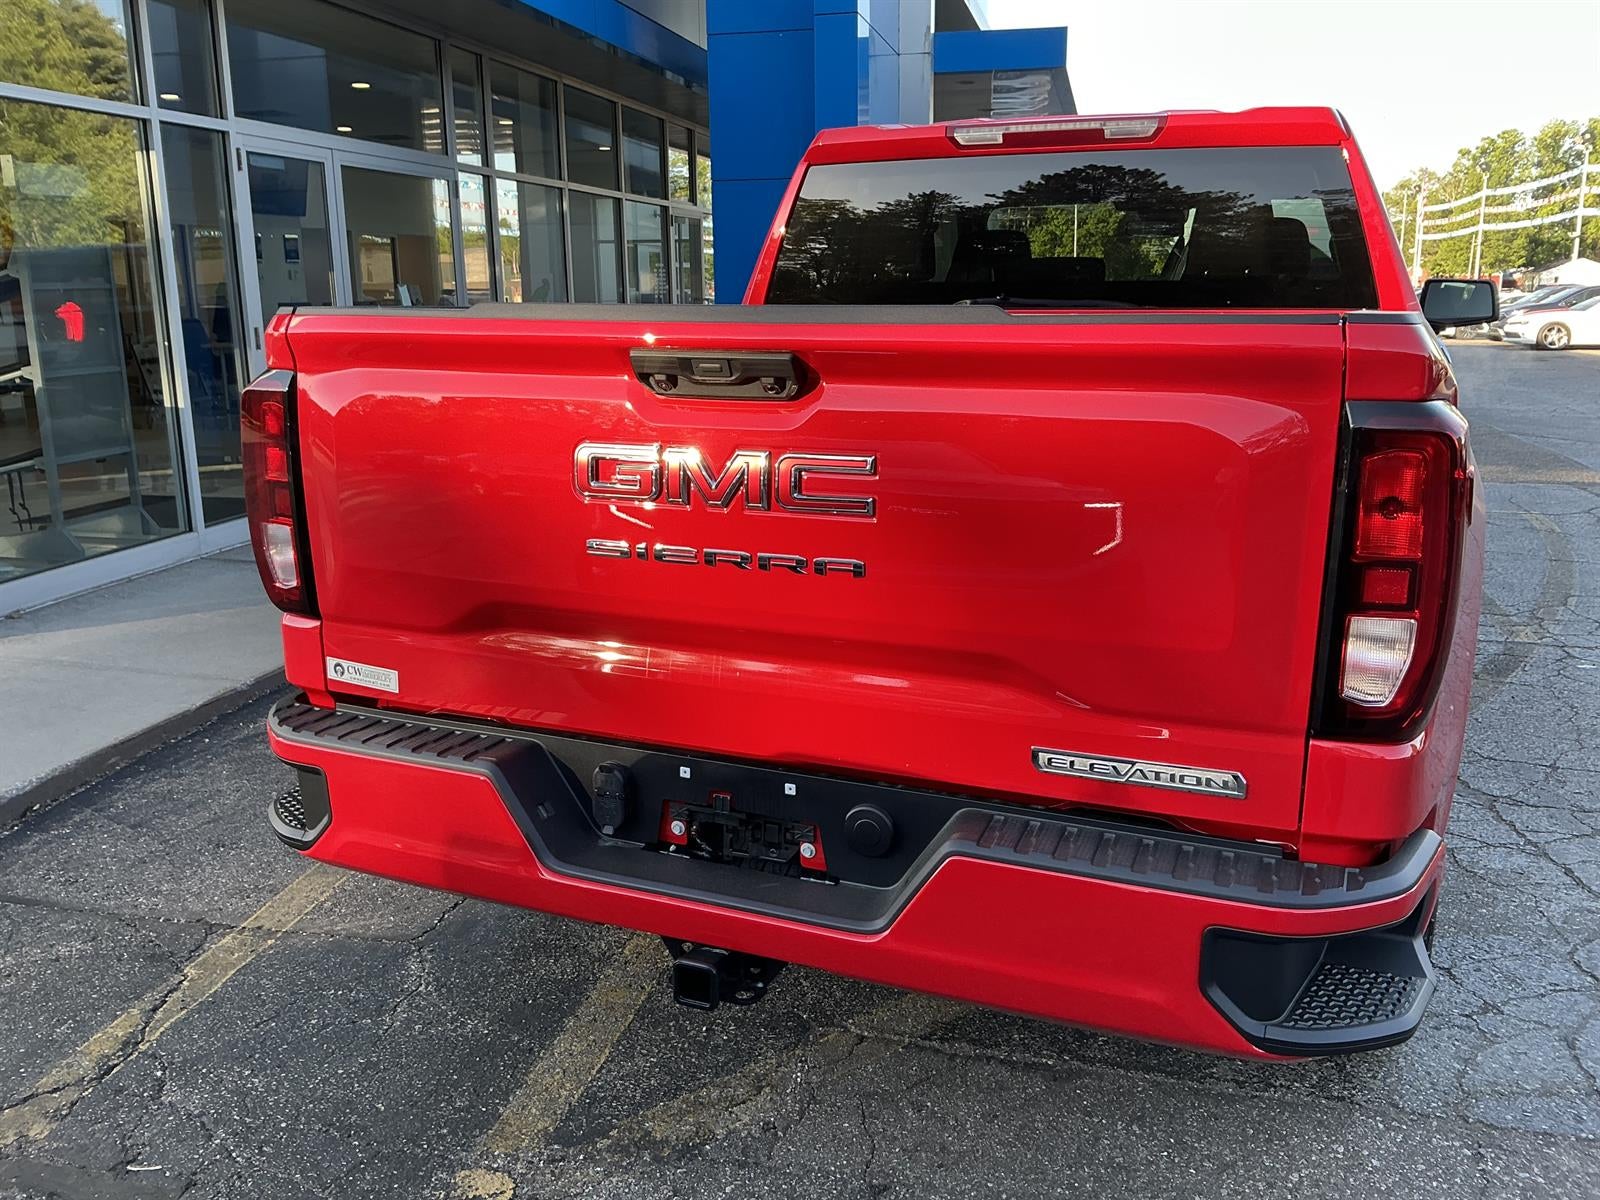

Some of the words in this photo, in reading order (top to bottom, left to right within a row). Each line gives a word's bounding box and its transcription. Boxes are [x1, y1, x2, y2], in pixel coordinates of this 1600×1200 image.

[574, 442, 877, 517] GMC
[586, 538, 867, 578] SIERRA
[1046, 756, 1233, 790] ELEVATION
